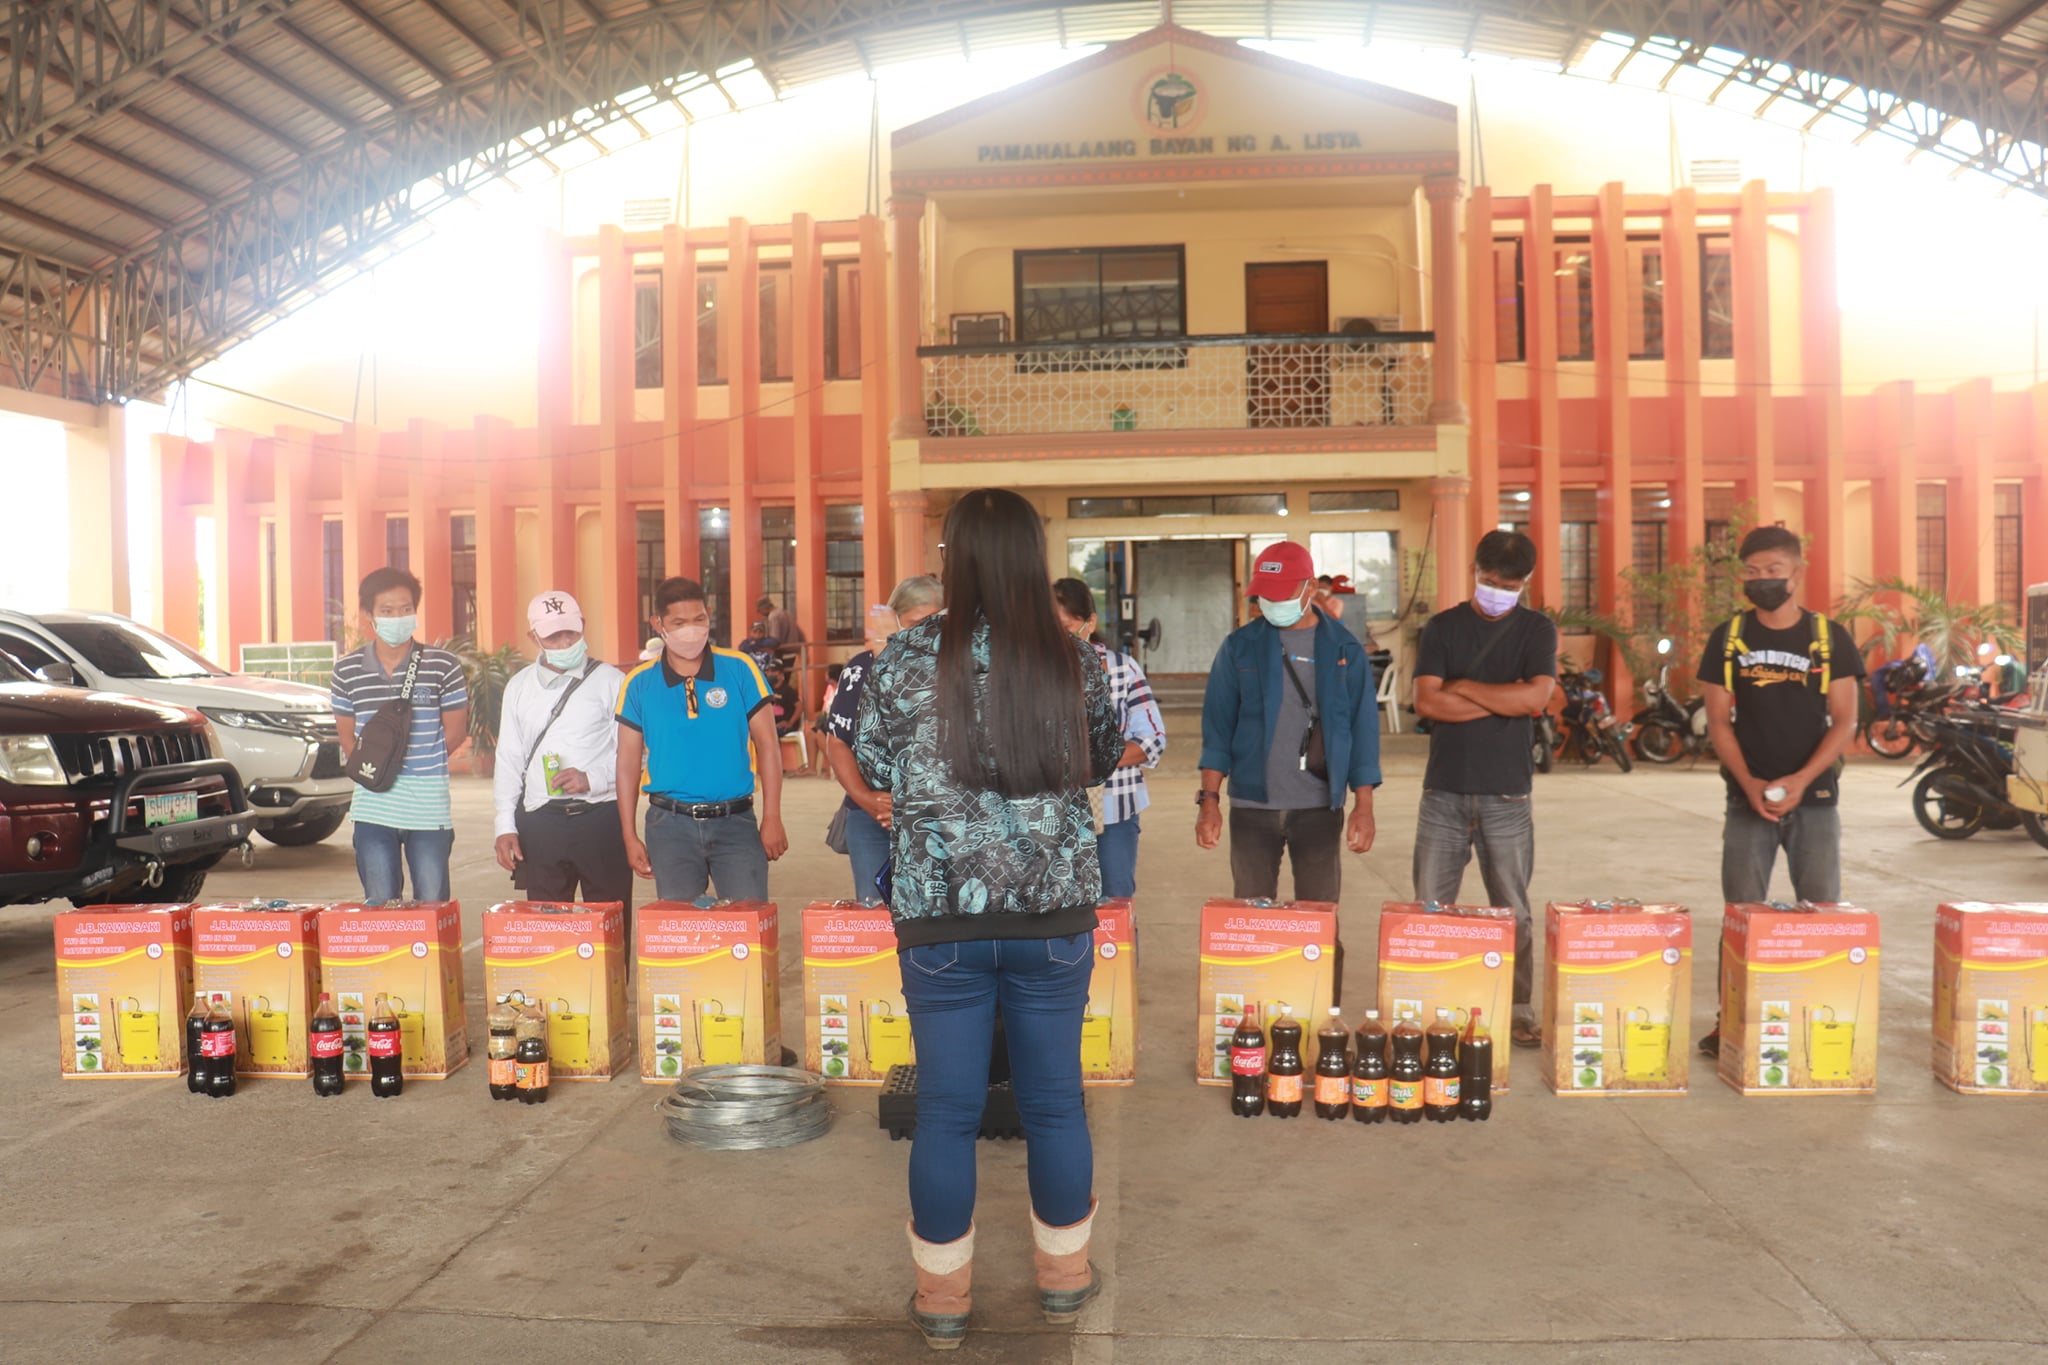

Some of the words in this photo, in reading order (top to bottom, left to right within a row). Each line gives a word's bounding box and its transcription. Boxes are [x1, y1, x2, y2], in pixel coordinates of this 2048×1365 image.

[977, 140, 1136, 162] PAMAHALAANG
[1150, 136, 1214, 155] BAYAN
[1227, 135, 1257, 152] NG
[1270, 133, 1291, 151] A.
[1303, 131, 1362, 150] LISTA
[542, 597, 566, 615] NY
[1767, 650, 1810, 672] DUTCH
[401, 662, 417, 699] adidas
[75, 921, 160, 934] J.B.KAWASAKI
[210, 920, 290, 931] J.B.KAWASAKI
[340, 920, 426, 932] J.B.KAWASAKI
[504, 921, 592, 932] J.B.KAWASAKI
[658, 920, 747, 932] J.B.KAWASAKI
[825, 920, 895, 932] J.B.KAWAS
[1224, 917, 1321, 933] J.B.KAWASAKI
[1403, 923, 1502, 940] J.B.KAWASAKI
[1582, 923, 1680, 937] J.B.KAWASA
[1986, 921, 2048, 935] J.B.KAW
